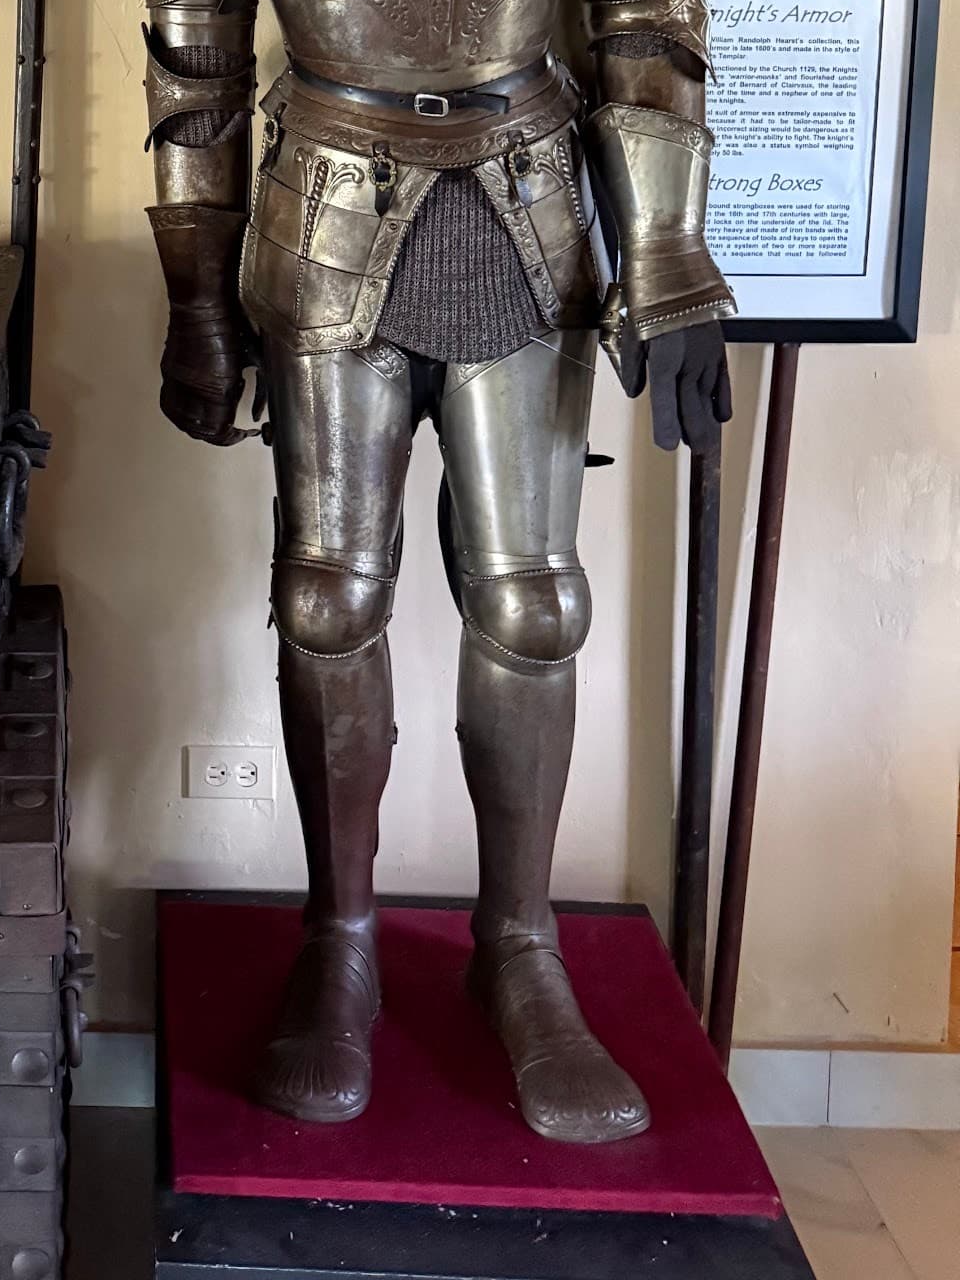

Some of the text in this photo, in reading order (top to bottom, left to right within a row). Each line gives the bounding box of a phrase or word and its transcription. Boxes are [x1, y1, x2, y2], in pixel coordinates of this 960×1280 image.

[710, 0, 853, 28] night's Armor
[737, 37, 772, 45] Randolph
[832, 66, 858, 74] Knights
[832, 82, 857, 90] leading
[812, 110, 847, 118] expensive
[802, 126, 839, 134] dangerous
[794, 142, 820, 150] symbol
[709, 173, 824, 197] trong Boxes
[826, 203, 850, 211] storing
